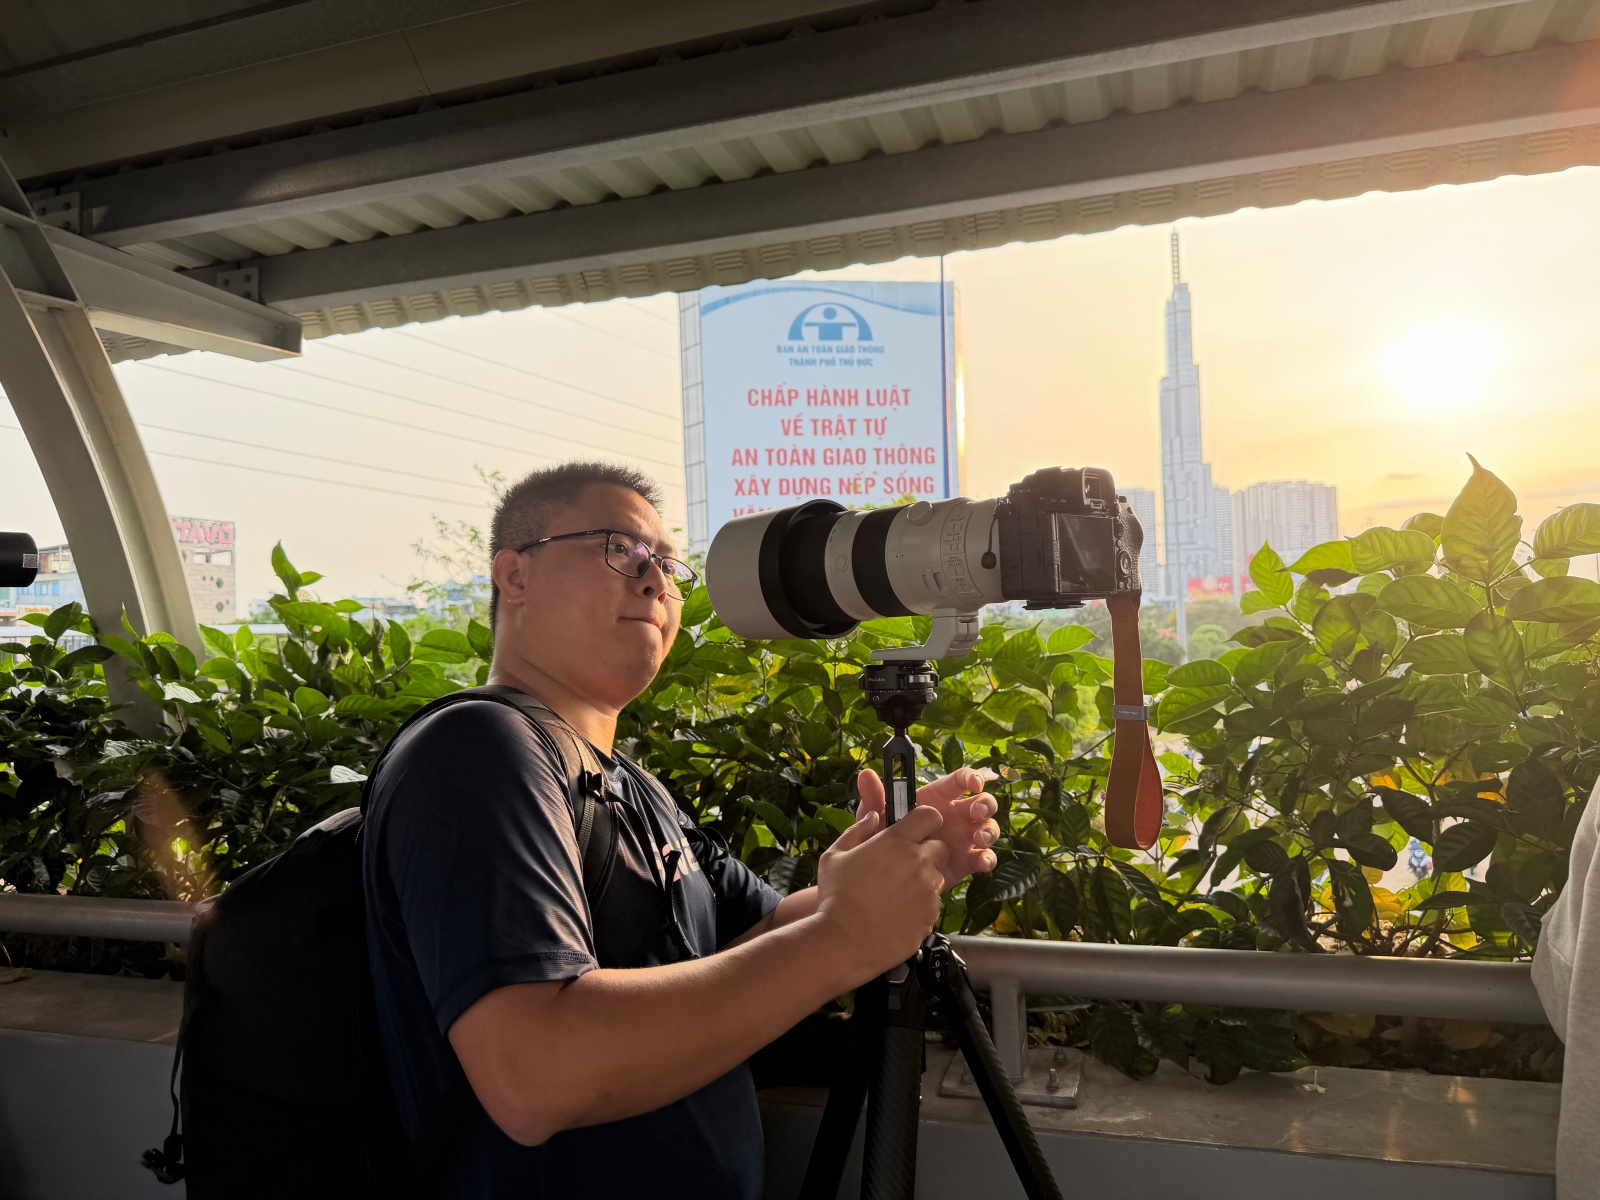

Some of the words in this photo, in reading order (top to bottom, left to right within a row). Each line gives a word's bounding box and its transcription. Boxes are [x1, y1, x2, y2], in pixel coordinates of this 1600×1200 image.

[776, 345, 794, 354] BAN
[796, 345, 809, 354] AN
[835, 345, 856, 354] GIAO
[747, 382, 799, 407] CHẤP
[806, 385, 859, 407] HÀNH
[865, 384, 911, 410] LUẬT
[810, 414, 857, 440] TRẬT
[863, 416, 888, 440] TỰ
[731, 448, 759, 466] AN
[765, 444, 816, 467] TOÀN
[822, 447, 867, 467] GIAO
[874, 444, 936, 466] THÔNG
[734, 474, 771, 496] XÂY
[778, 476, 832, 500] DỰNG
[838, 468, 876, 496] NẾP
[883, 470, 935, 495] SỐNG
